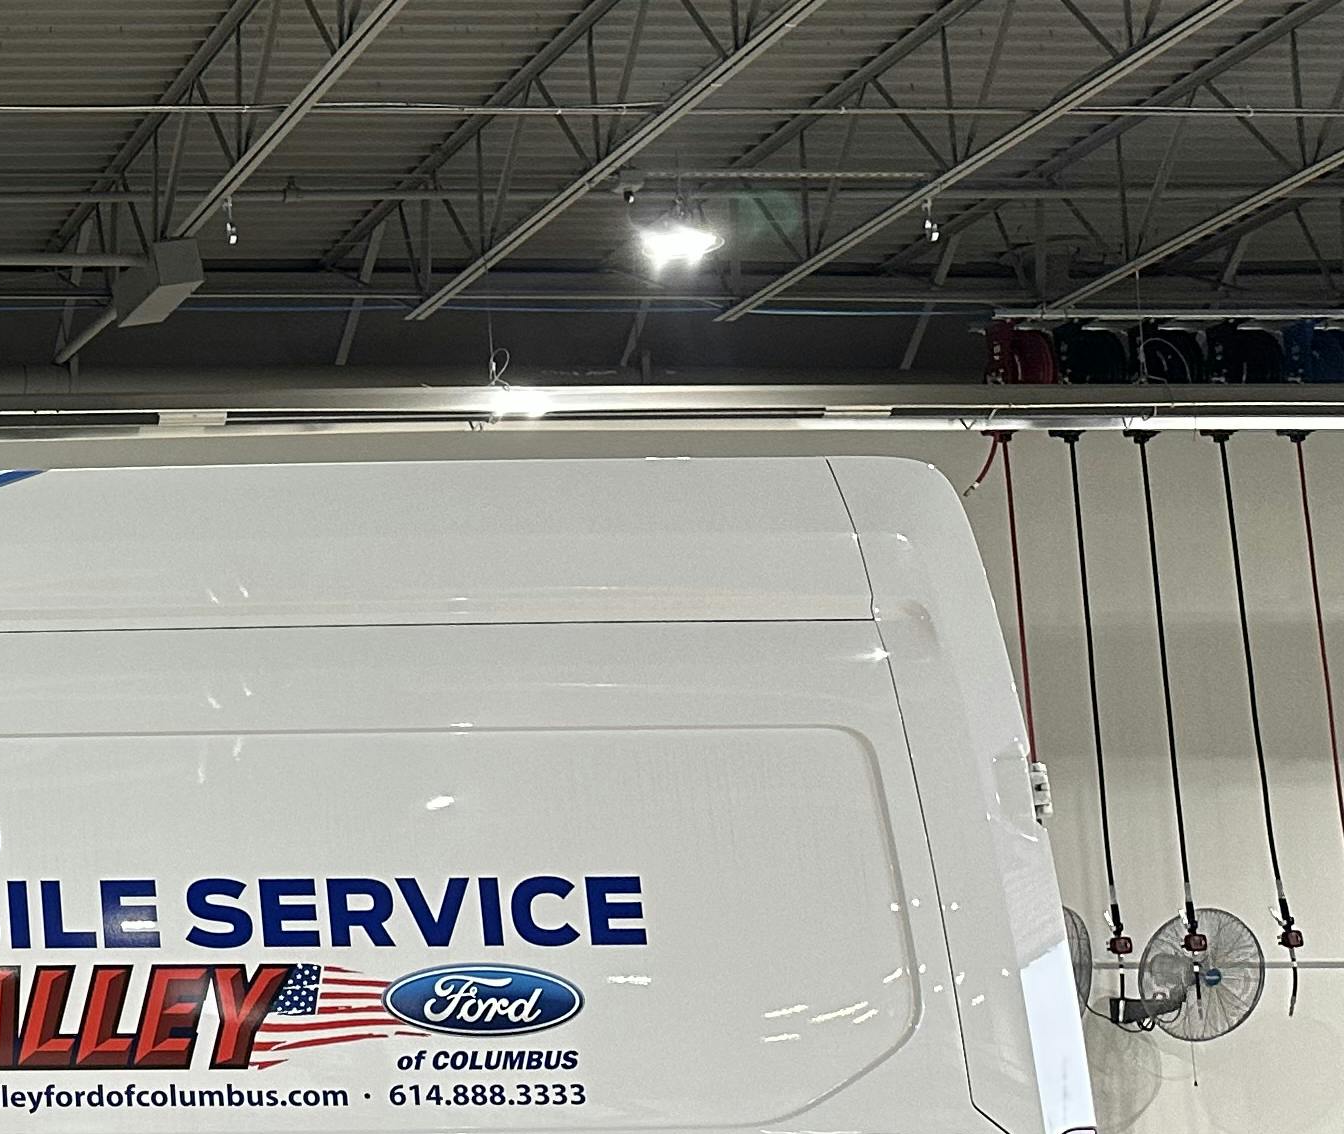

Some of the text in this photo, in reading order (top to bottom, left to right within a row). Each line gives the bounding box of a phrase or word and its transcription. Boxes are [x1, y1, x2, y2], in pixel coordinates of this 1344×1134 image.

[185, 875, 648, 949] SERVICE
[423, 974, 543, 1023] Ford
[397, 1050, 579, 1071] of COLUMBUS
[389, 1083, 586, 1106] 614.888.3333
